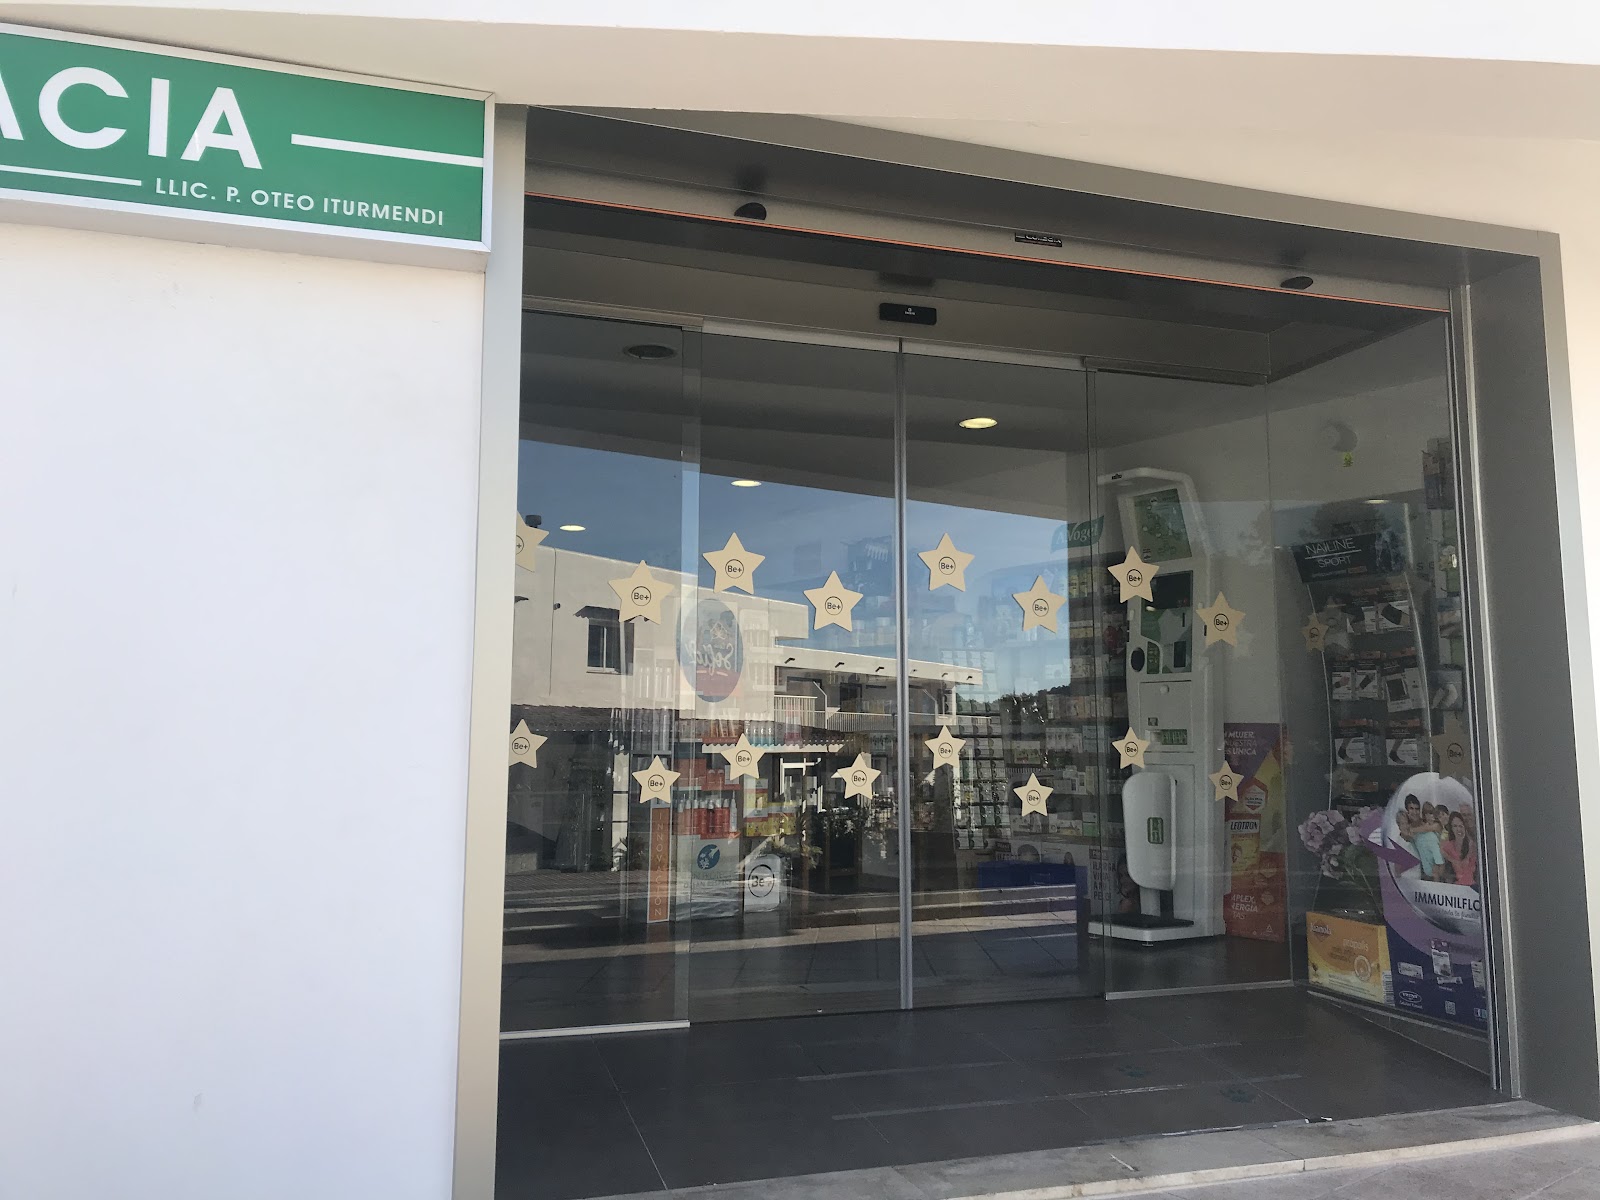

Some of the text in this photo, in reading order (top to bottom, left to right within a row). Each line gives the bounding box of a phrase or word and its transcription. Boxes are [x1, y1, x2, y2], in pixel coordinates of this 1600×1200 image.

[0, 66, 263, 170] CIA
[155, 177, 444, 226] LLIC. P. OTEO ITURMENDI
[1305, 537, 1356, 556] NAILINE
[1317, 555, 1352, 568] SPORT
